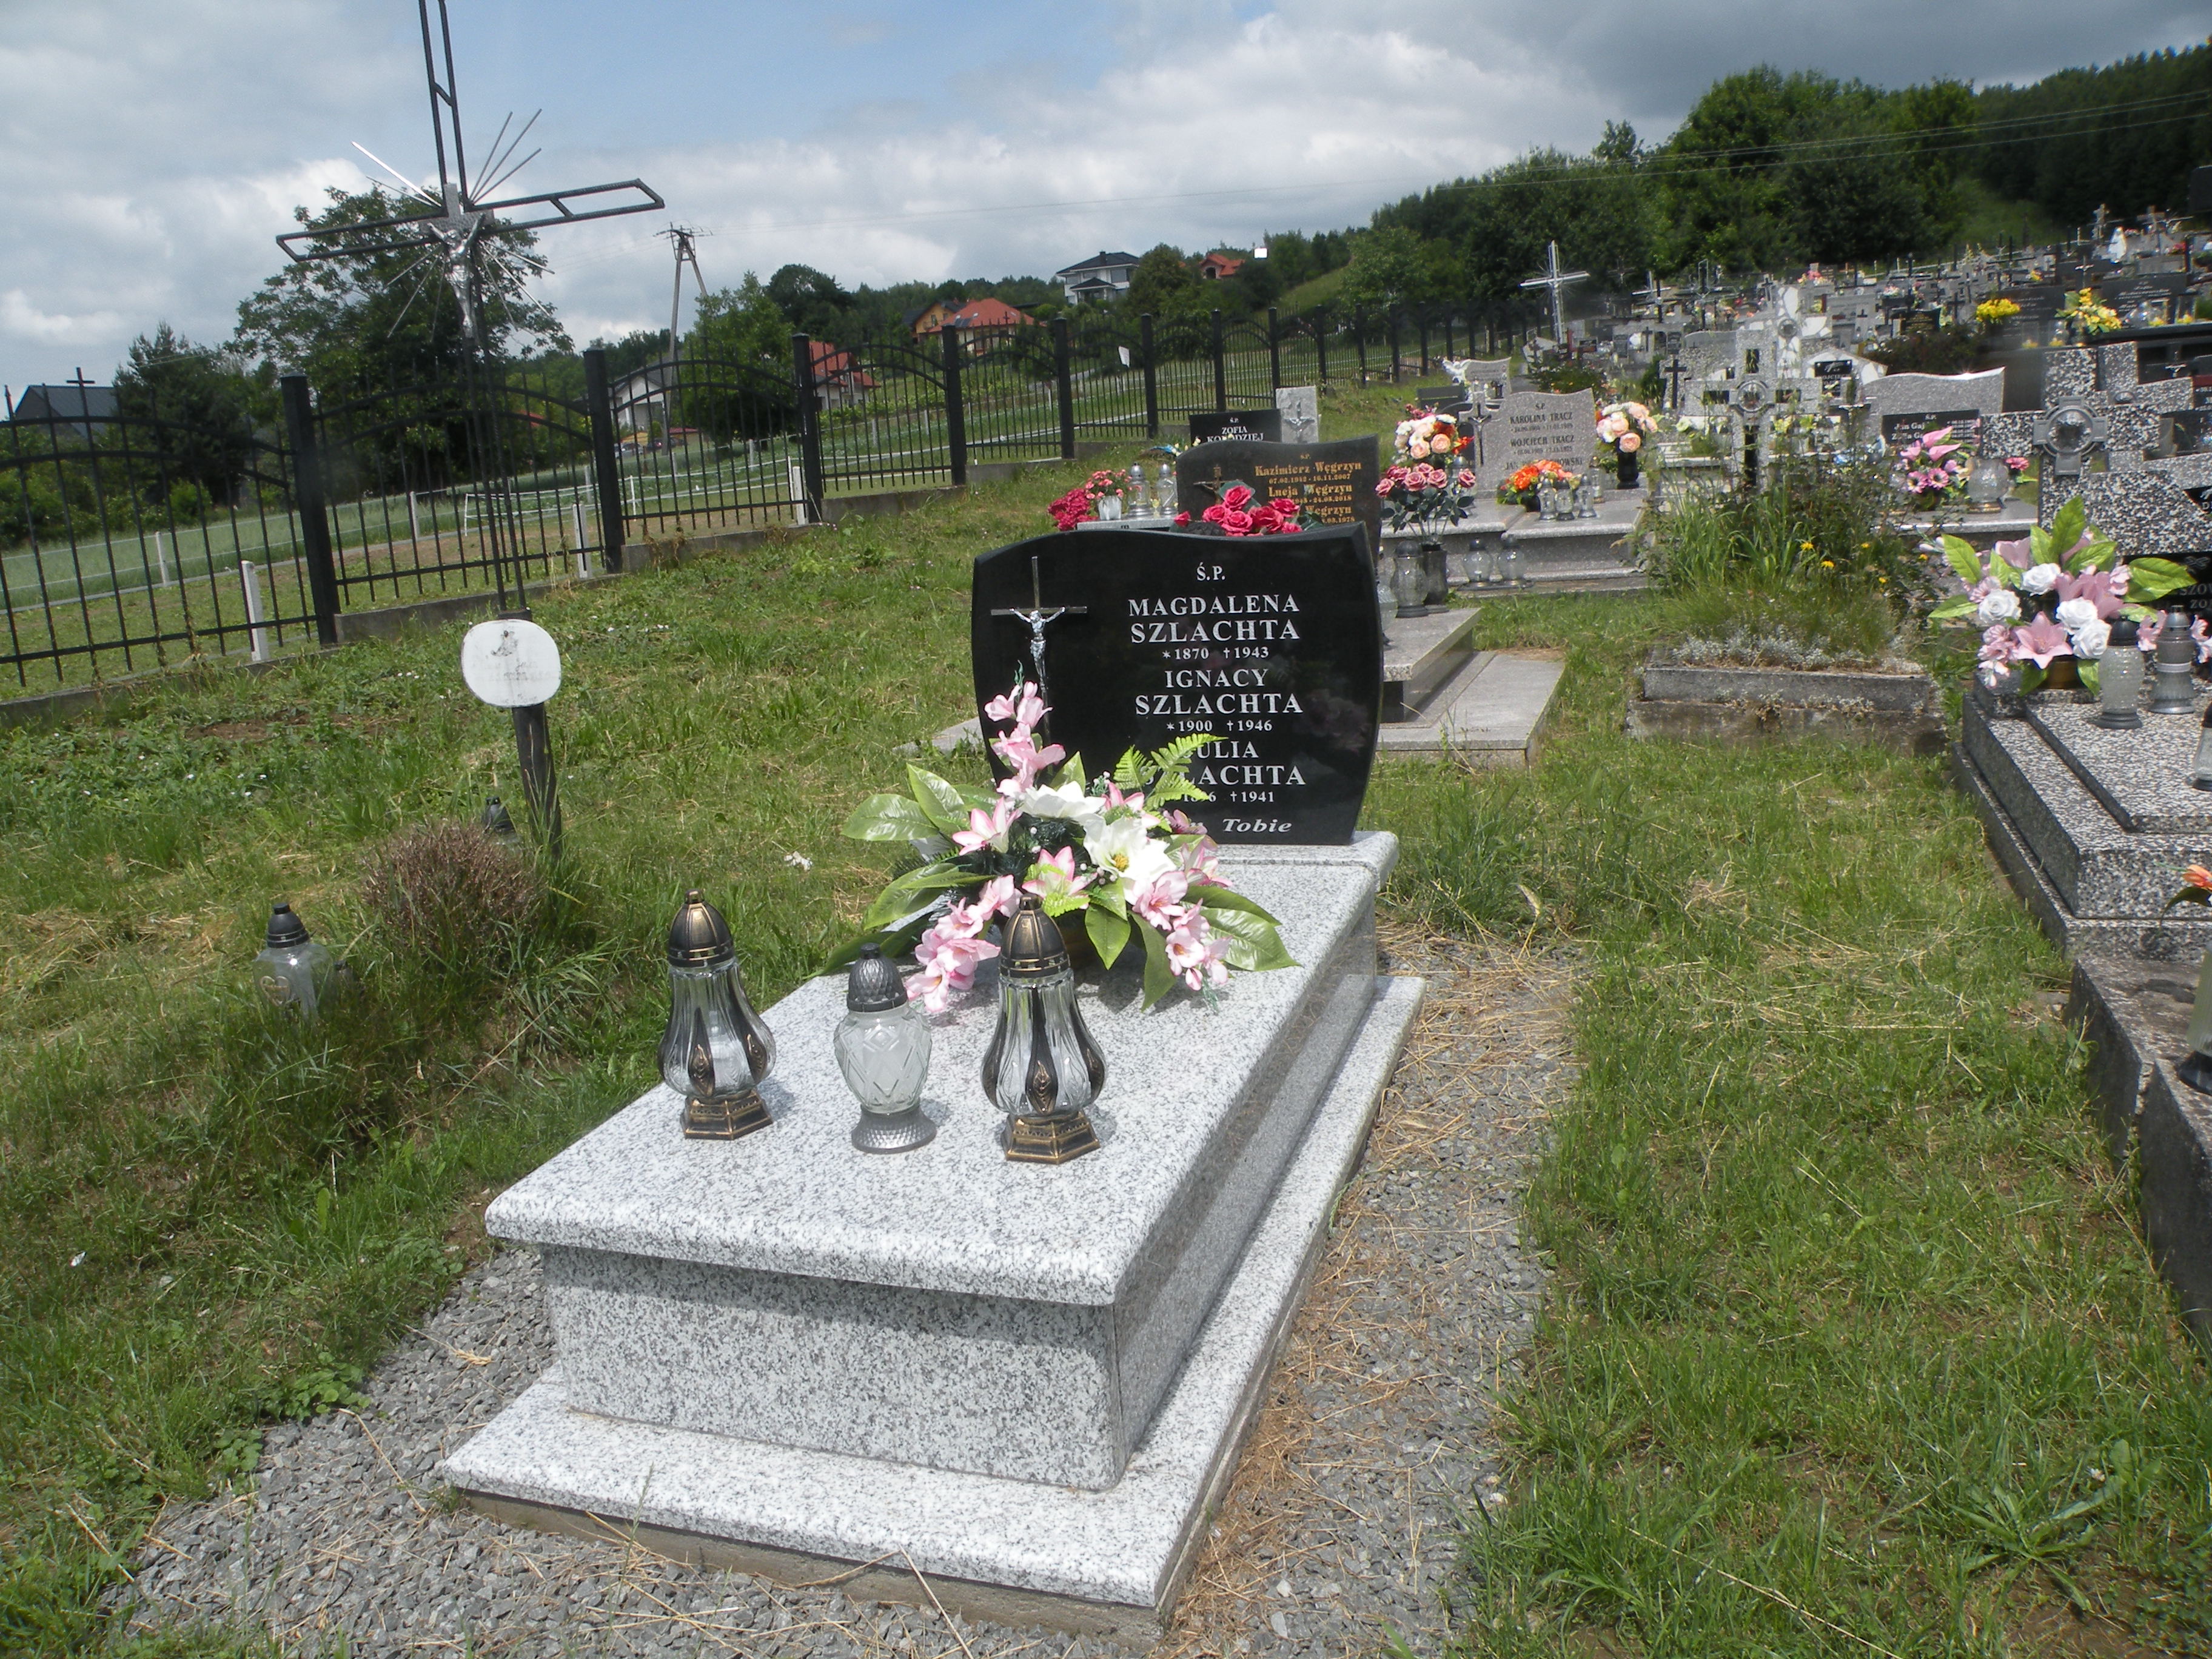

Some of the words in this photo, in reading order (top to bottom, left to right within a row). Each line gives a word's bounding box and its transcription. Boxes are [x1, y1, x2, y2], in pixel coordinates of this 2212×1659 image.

[1510, 414, 1546, 424] KAROLINA
[1550, 412, 1573, 421] TRACZ
[1206, 432, 1264, 443] KOODZIEJ
[1221, 426, 1248, 435] ZOFIA
[1510, 437, 1548, 447] WOJCIECH
[1552, 435, 1575, 444] TRACZ
[1255, 464, 1310, 477] Kazimierz
[1315, 461, 1362, 474] Węgrzyn
[1127, 594, 1300, 618] MAGDALENA
[1130, 619, 1300, 643] SZLACHTA
[1164, 668, 1269, 688] IGNACY
[1135, 692, 1304, 716] SZLACHTA
[1221, 819, 1293, 833] Tobie
